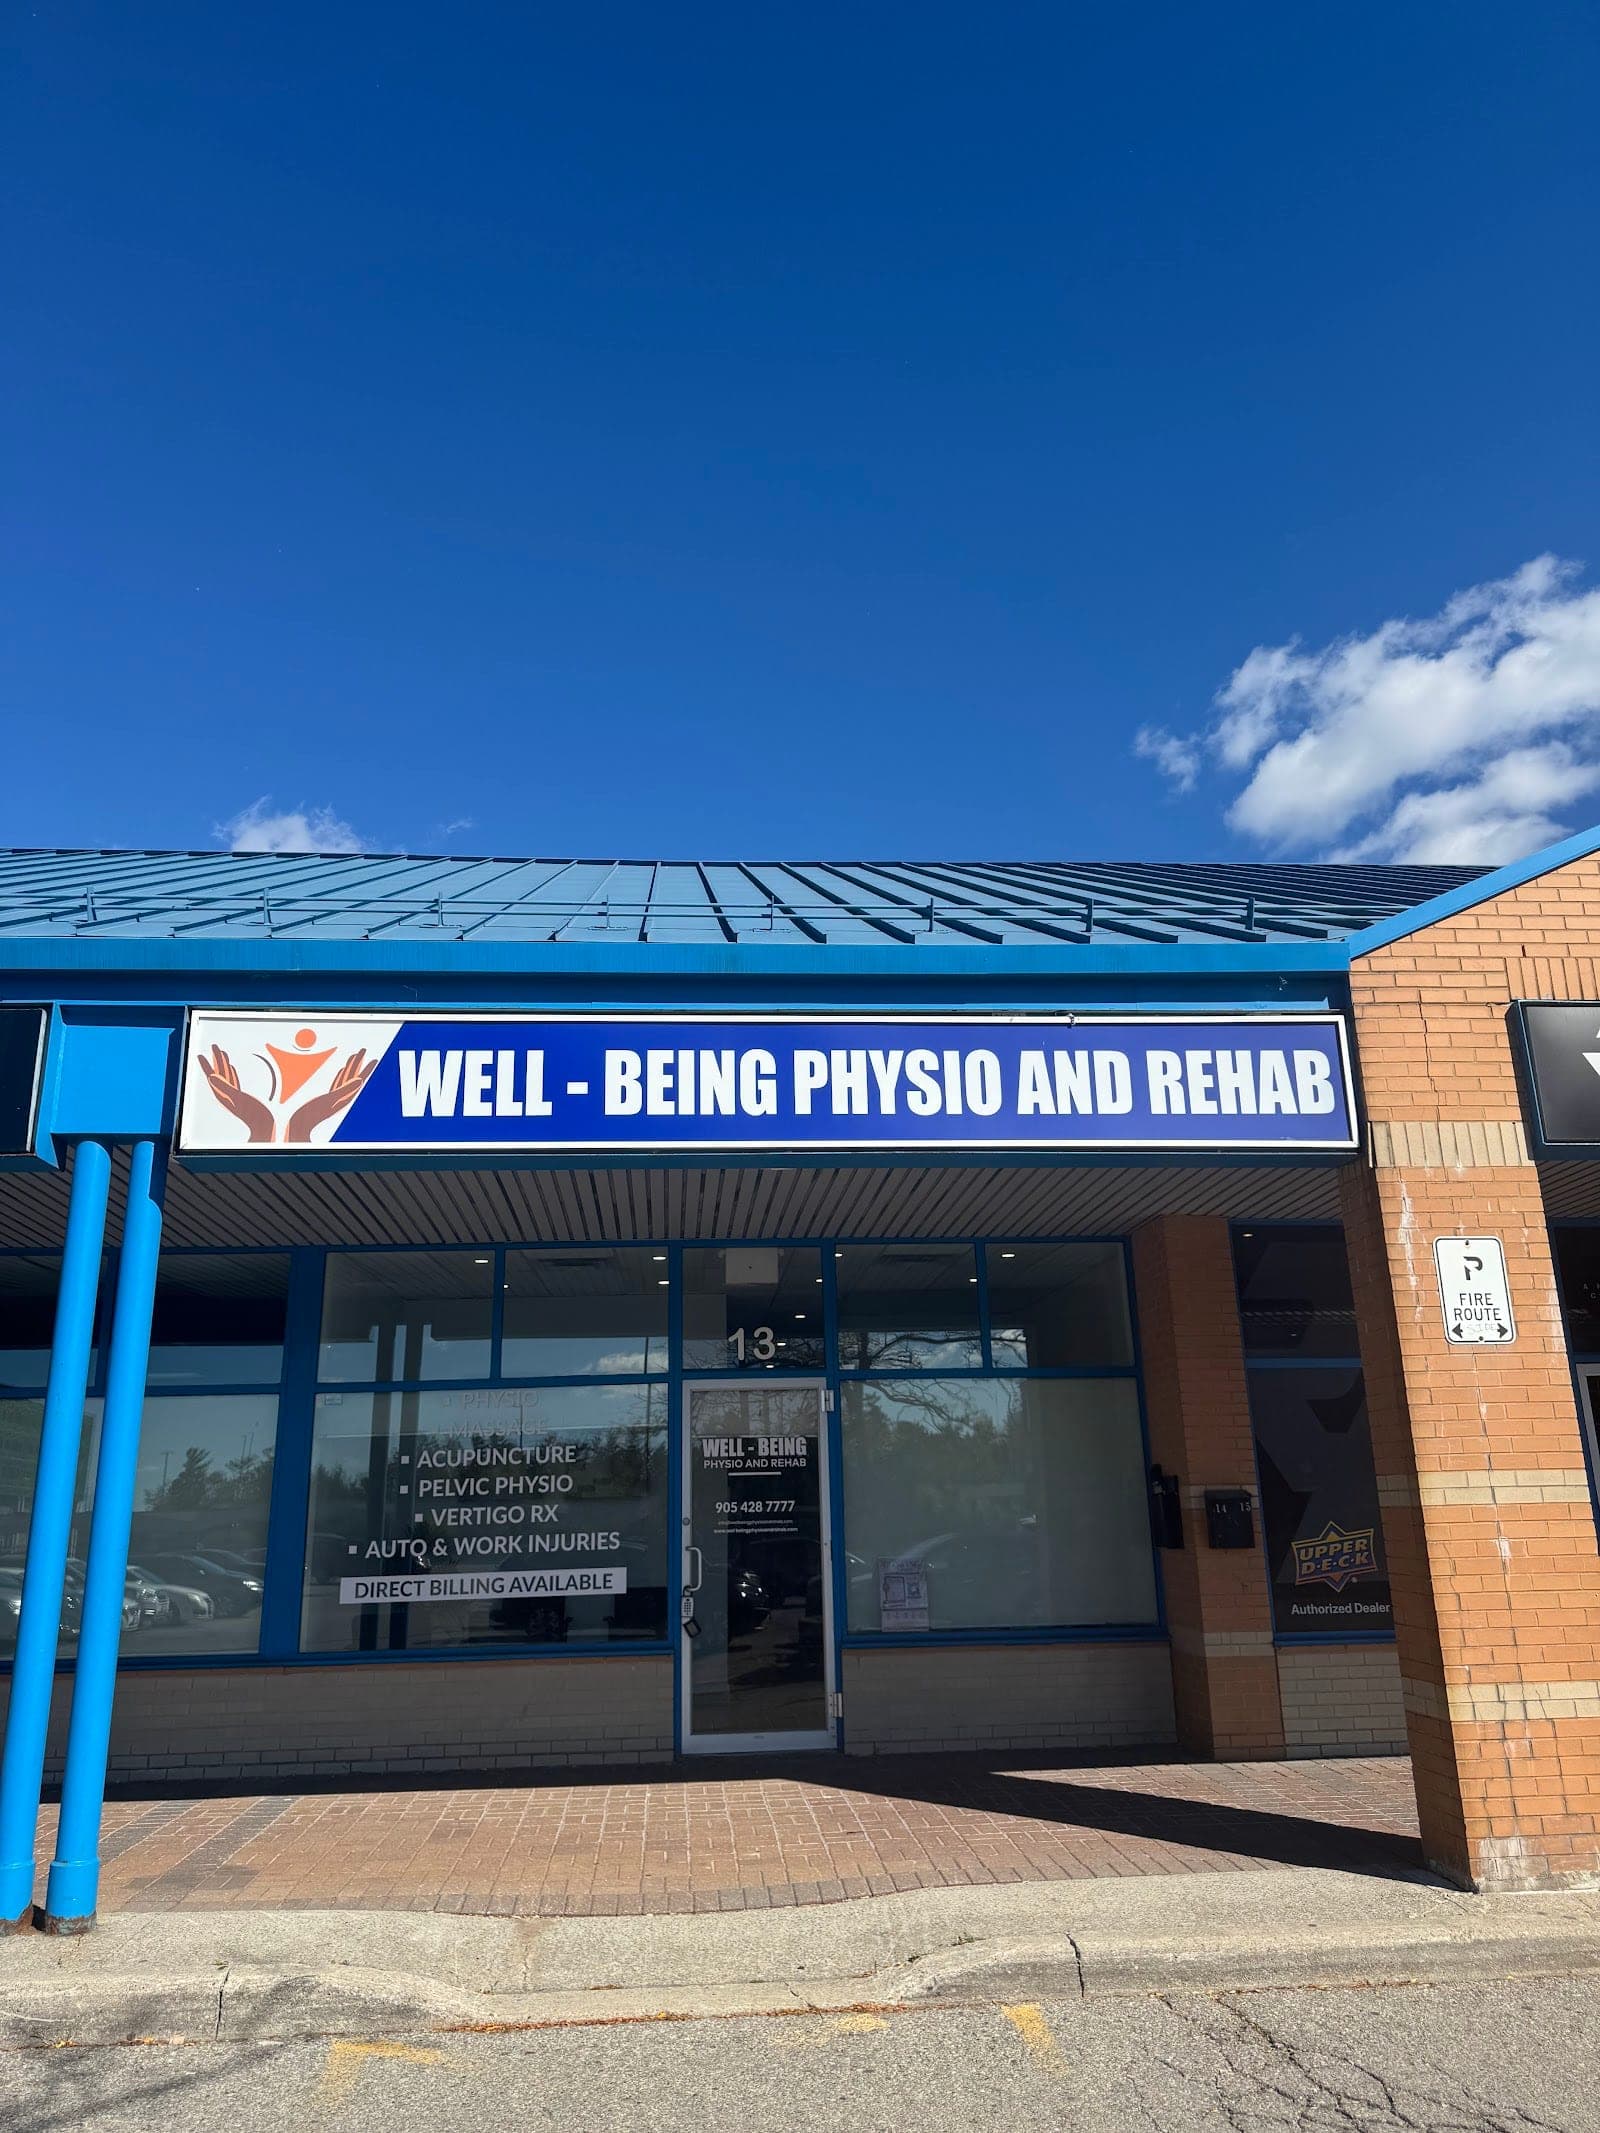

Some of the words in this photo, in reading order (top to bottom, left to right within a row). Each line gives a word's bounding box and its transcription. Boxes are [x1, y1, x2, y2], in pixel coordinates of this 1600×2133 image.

[398, 1050, 552, 1118] WELL
[604, 1049, 777, 1117] BEING
[793, 1048, 1002, 1116] PHYSIO
[1017, 1050, 1132, 1115] AND
[1147, 1050, 1335, 1115] REHAB
[1459, 1293, 1494, 1306] FIRE
[1453, 1308, 1502, 1321] ROUTE
[728, 1326, 776, 1361] 13
[417, 1446, 577, 1469] ACUPUNCTURE
[702, 1438, 745, 1457] WELL
[758, 1437, 807, 1456] BEING
[703, 1460, 742, 1469] PHYSIO
[745, 1459, 769, 1469] AND
[771, 1458, 807, 1468] REHAB
[418, 1478, 490, 1497] PELVIC
[495, 1474, 574, 1495] PHYSIO
[431, 1506, 525, 1526] VERTIGO
[531, 1504, 559, 1522] RX
[715, 1502, 738, 1513] 905
[740, 1501, 763, 1513] 428
[766, 1500, 796, 1512] 7777
[365, 1539, 427, 1559] AUTO
[432, 1537, 449, 1557] &
[453, 1535, 523, 1555] WORK
[528, 1531, 621, 1552] INJURIES
[1299, 1538, 1368, 1561] UPPER
[355, 1581, 425, 1600] DIRECT
[430, 1577, 505, 1596] BILLING
[509, 1573, 613, 1593] AVAILABLE
[1291, 1603, 1353, 1615] Authorized
[1354, 1602, 1391, 1614] Dealer
